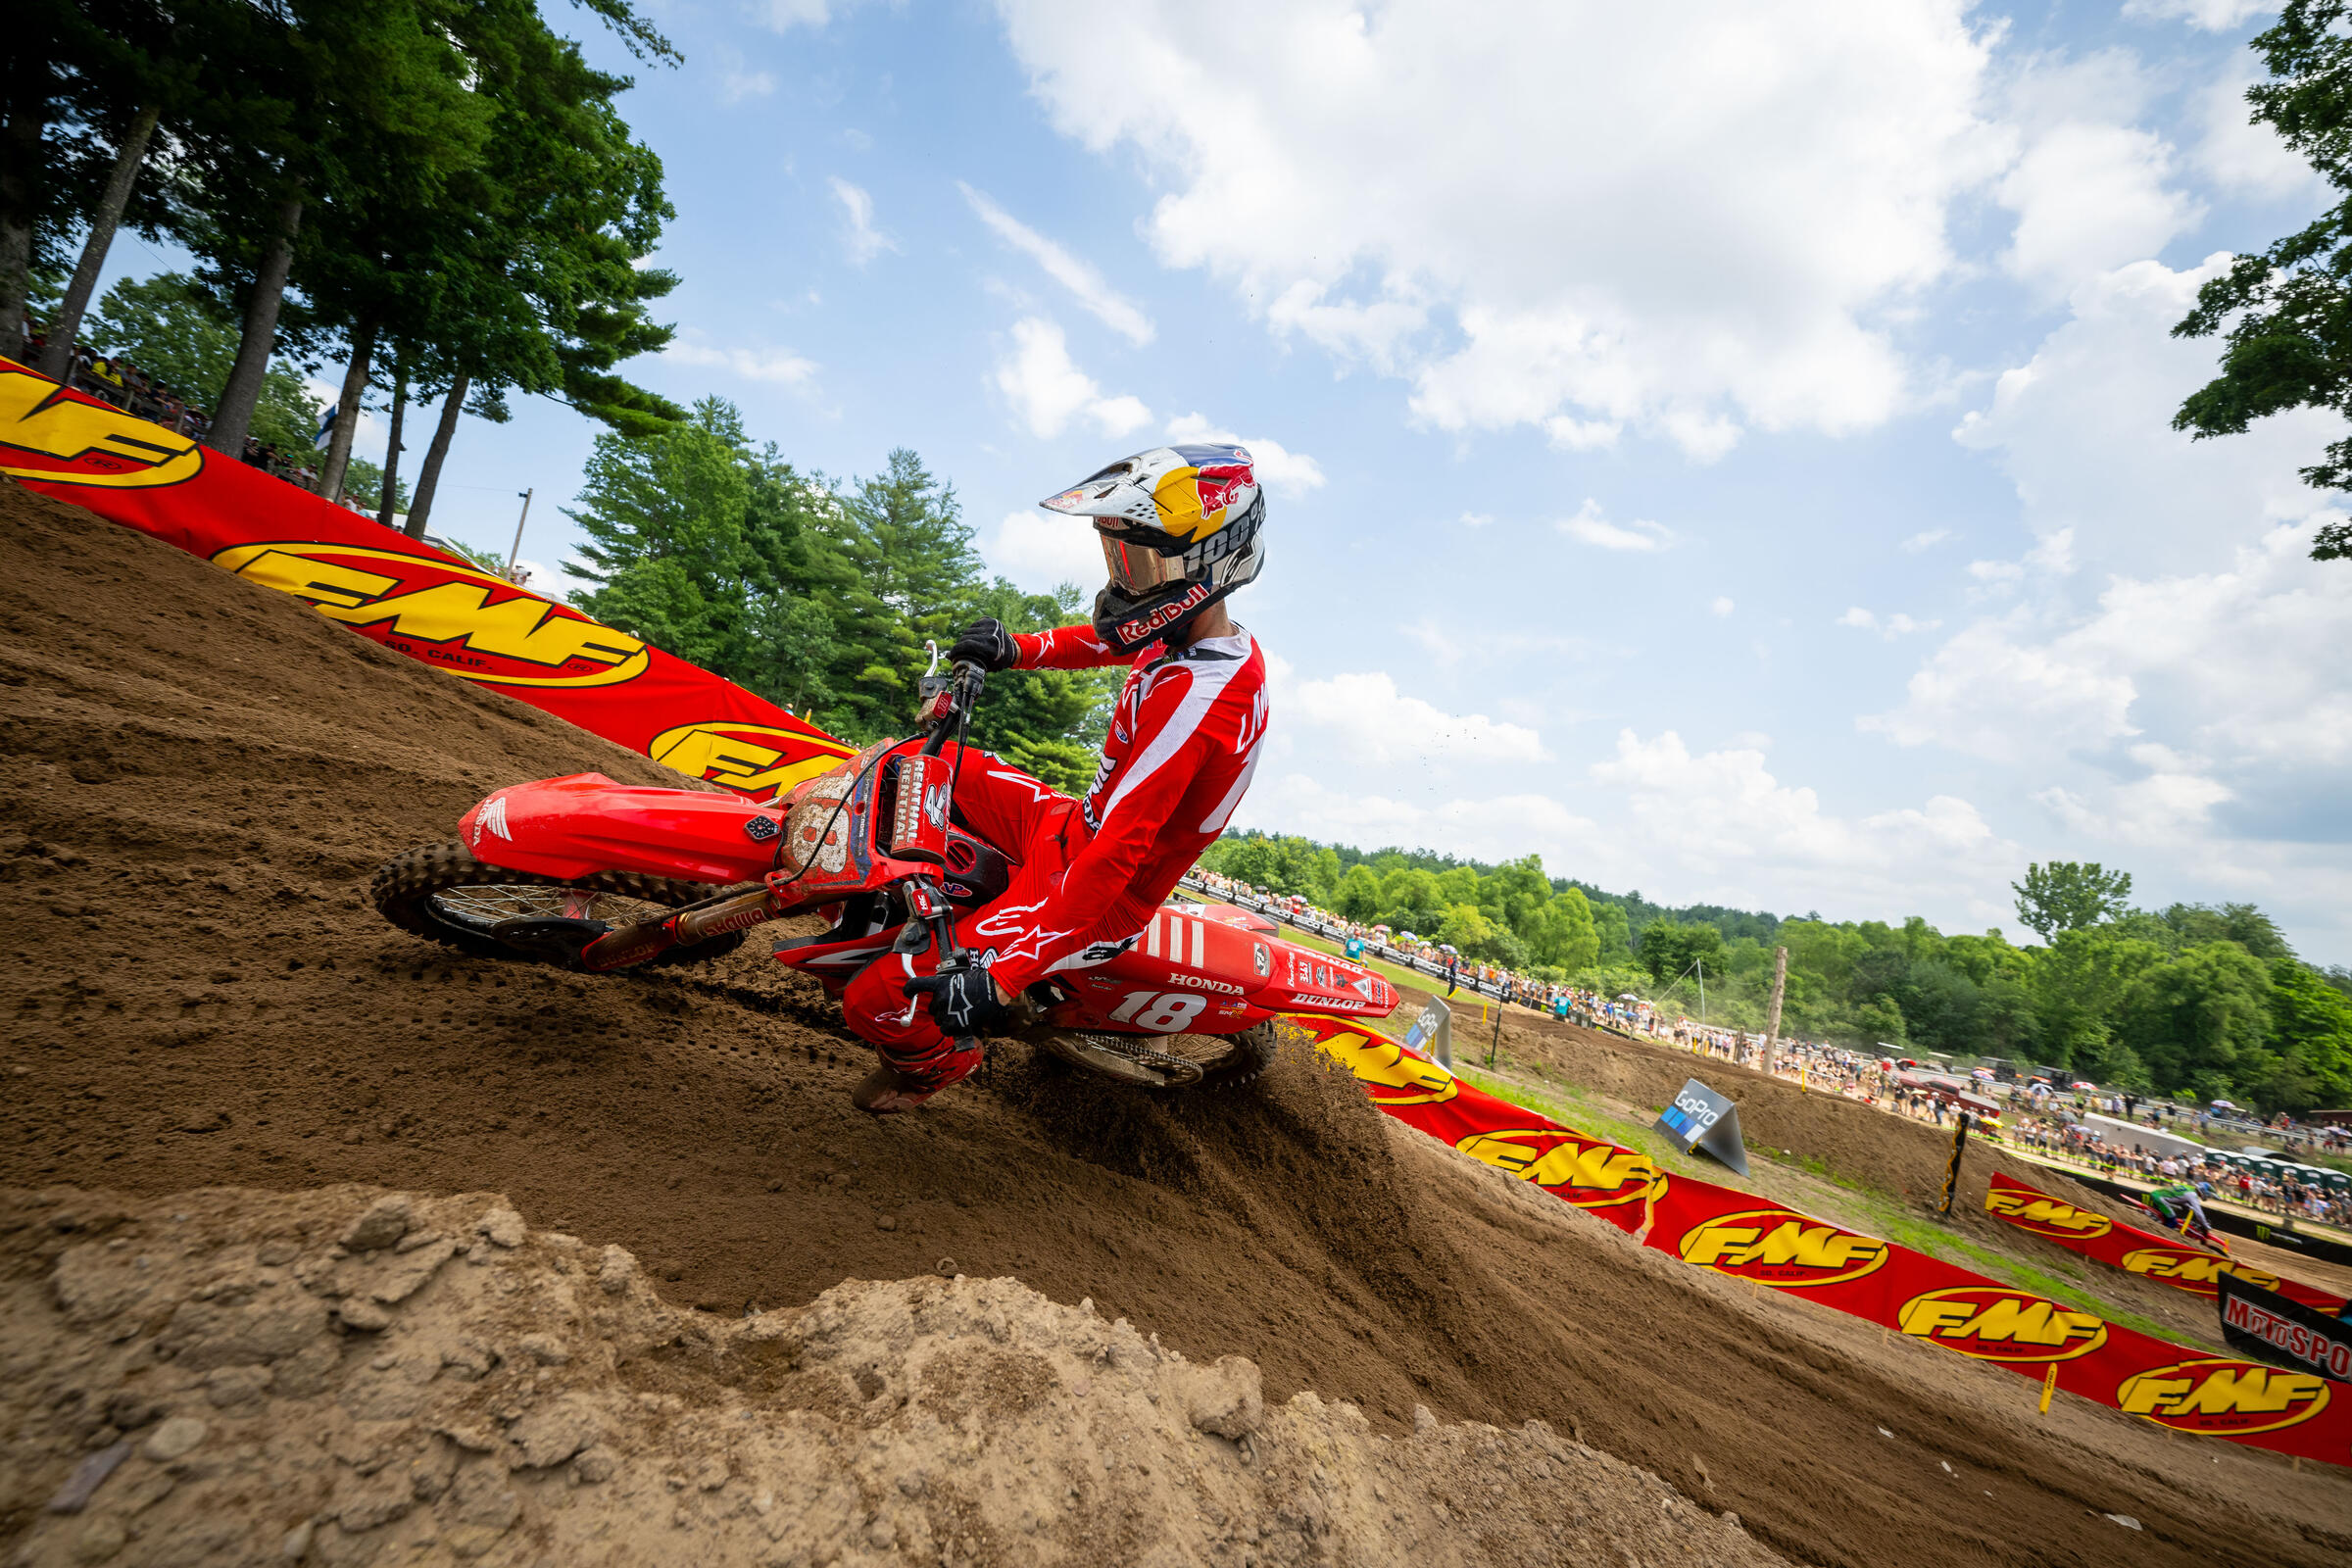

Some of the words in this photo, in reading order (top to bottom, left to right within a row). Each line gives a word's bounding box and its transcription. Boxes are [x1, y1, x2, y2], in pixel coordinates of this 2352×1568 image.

[233, 550, 646, 668] FMF
[1115, 609, 1167, 645] Red
[1158, 583, 1210, 621] Bull
[427, 649, 493, 670] CALIF.
[473, 798, 494, 847] HONDA
[895, 762, 912, 845] RENTHAL
[906, 760, 924, 843] RENTHAL
[1168, 973, 1245, 996] HONDA
[1291, 993, 1366, 1010] DUNLOP
[1108, 991, 1207, 1032] 18
[1675, 1090, 1719, 1126] GoPro
[1466, 1137, 1665, 1192] FMF
[1985, 1193, 2111, 1231] FMF
[1684, 1221, 1887, 1269] FMF
[1901, 1298, 2105, 1348] FMF
[2122, 1367, 2325, 1418] FMF
